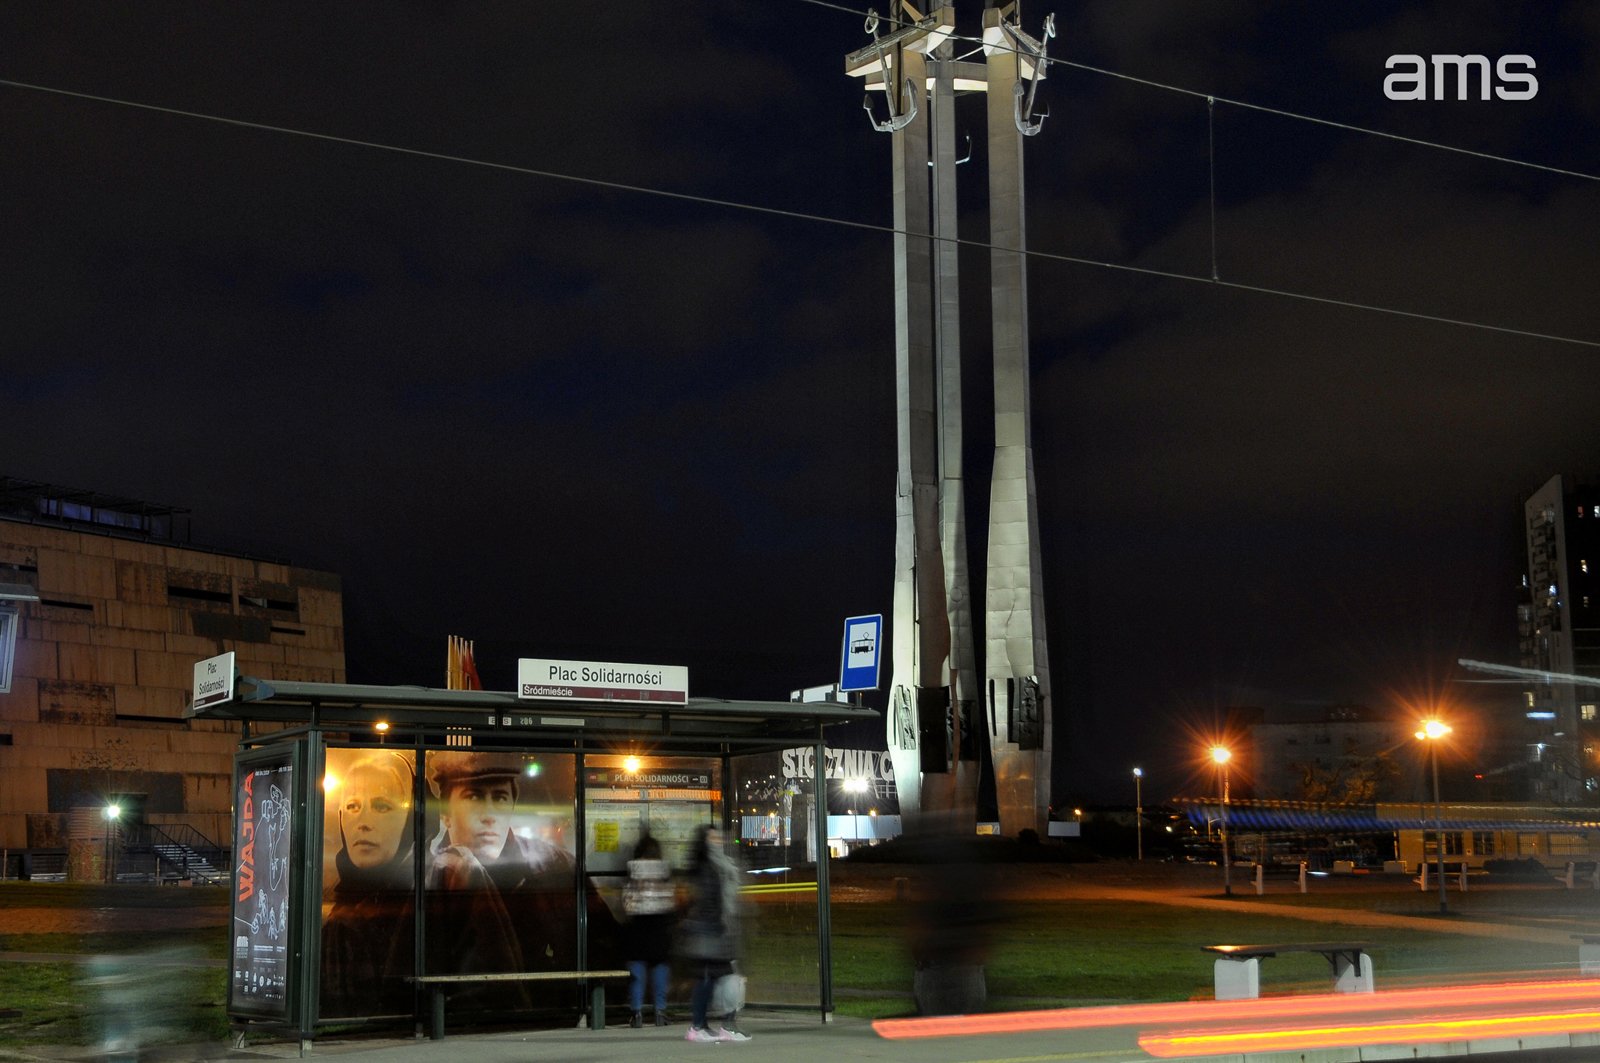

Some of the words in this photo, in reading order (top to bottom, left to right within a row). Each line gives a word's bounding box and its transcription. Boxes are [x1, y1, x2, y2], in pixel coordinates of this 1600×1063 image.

[207, 661, 217, 675] Plac
[549, 665, 578, 682] Plac
[581, 667, 662, 685] Solidarności
[198, 675, 225, 695] Solidarności
[523, 684, 573, 697] Śródmieście
[614, 774, 634, 783] PLAC
[635, 774, 689, 783] SOLIDARNOŚCI
[239, 771, 255, 902] WAJDA
